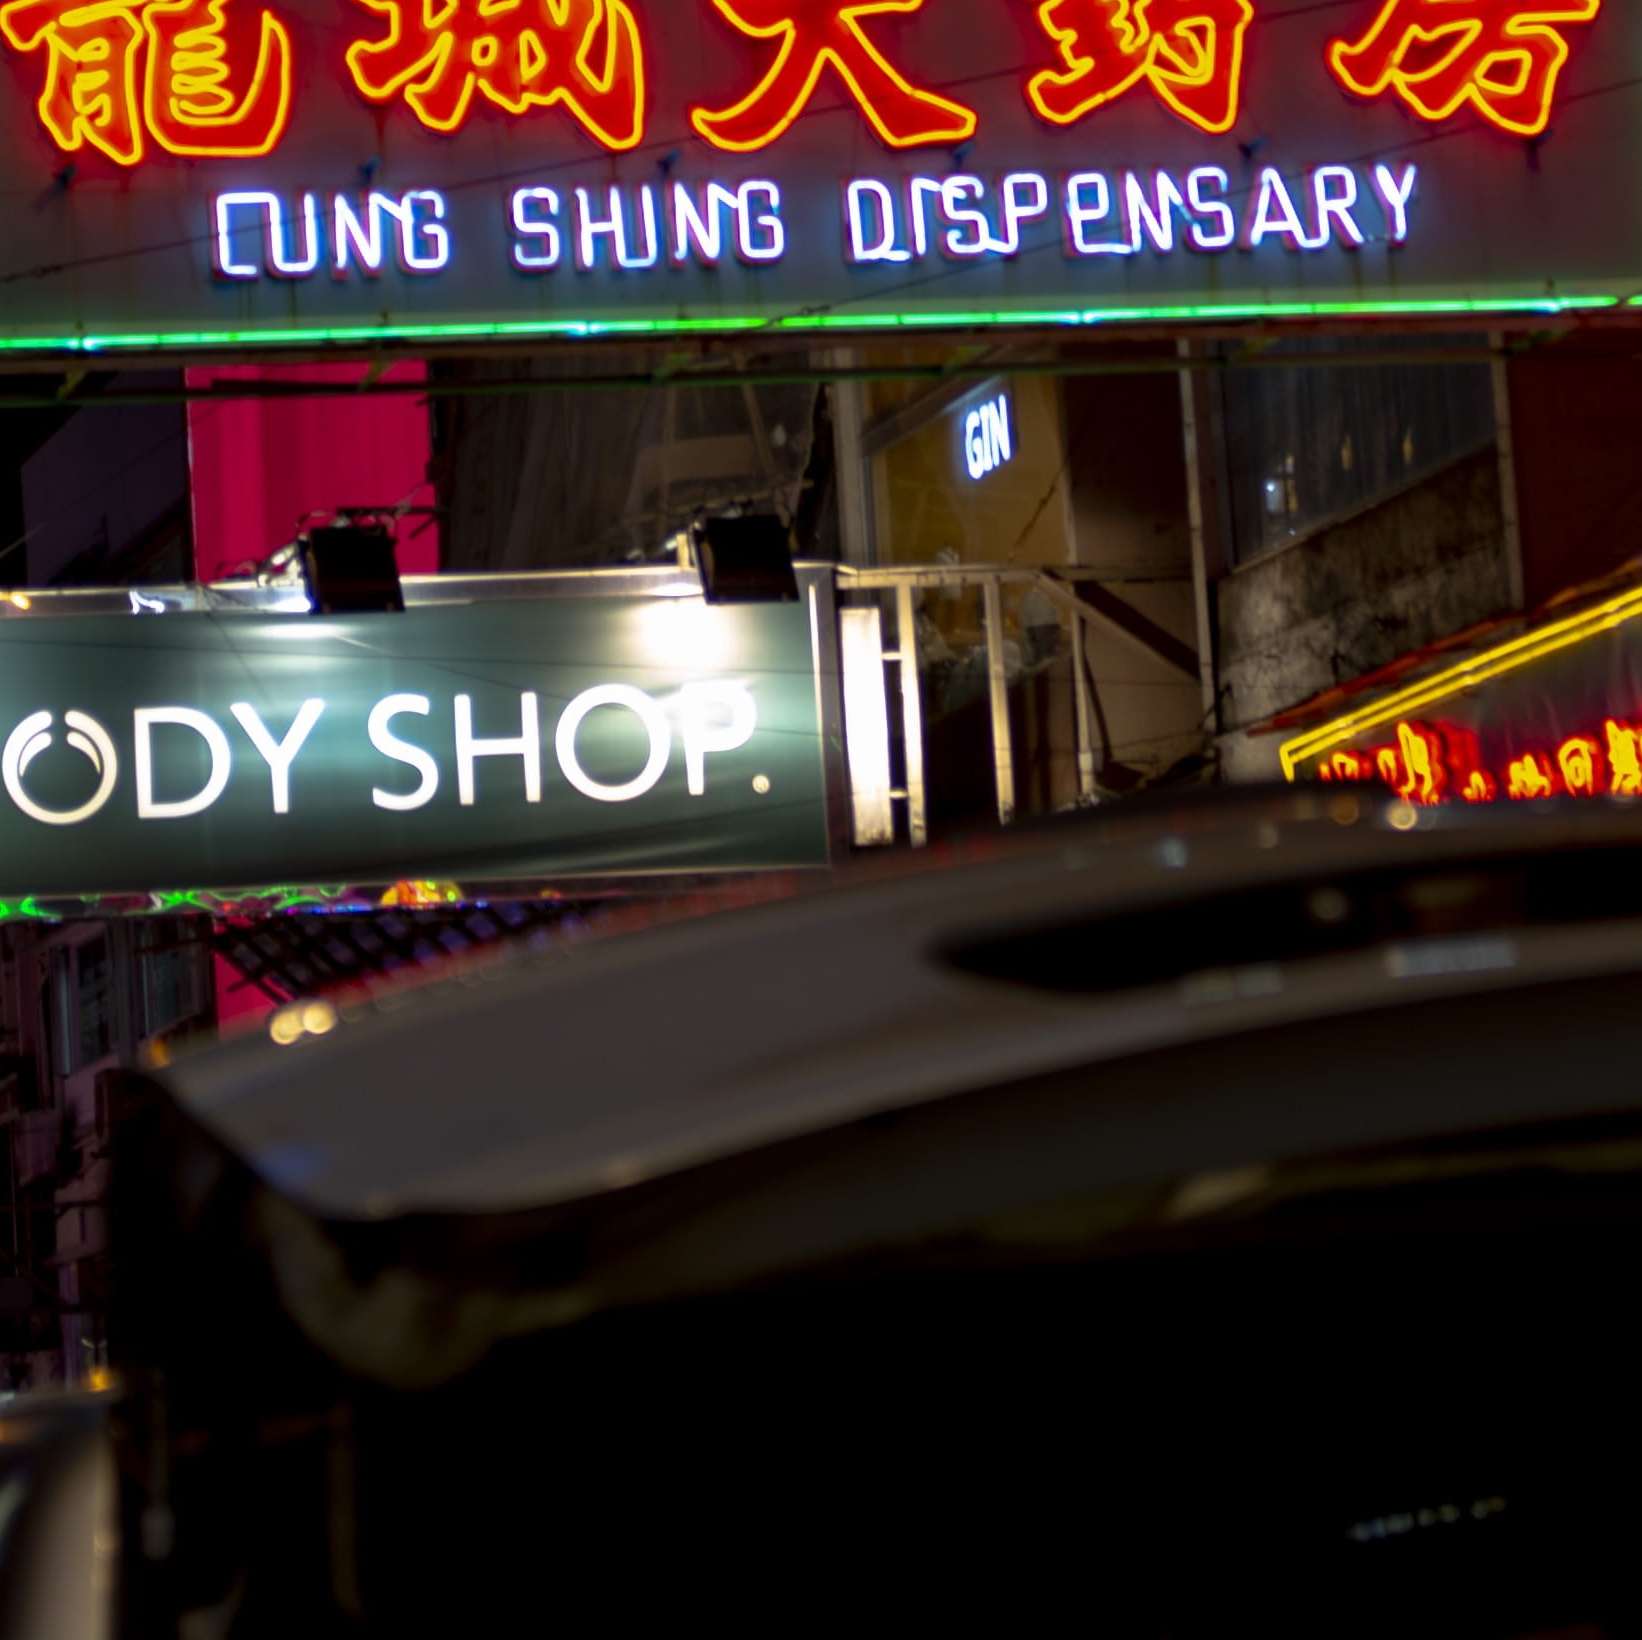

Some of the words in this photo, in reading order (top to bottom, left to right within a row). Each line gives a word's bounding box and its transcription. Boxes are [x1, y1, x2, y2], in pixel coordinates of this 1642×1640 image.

[512, 180, 787, 270] SHING
[846, 164, 1417, 264] DISPENSARY
[965, 394, 1012, 479] GIN
